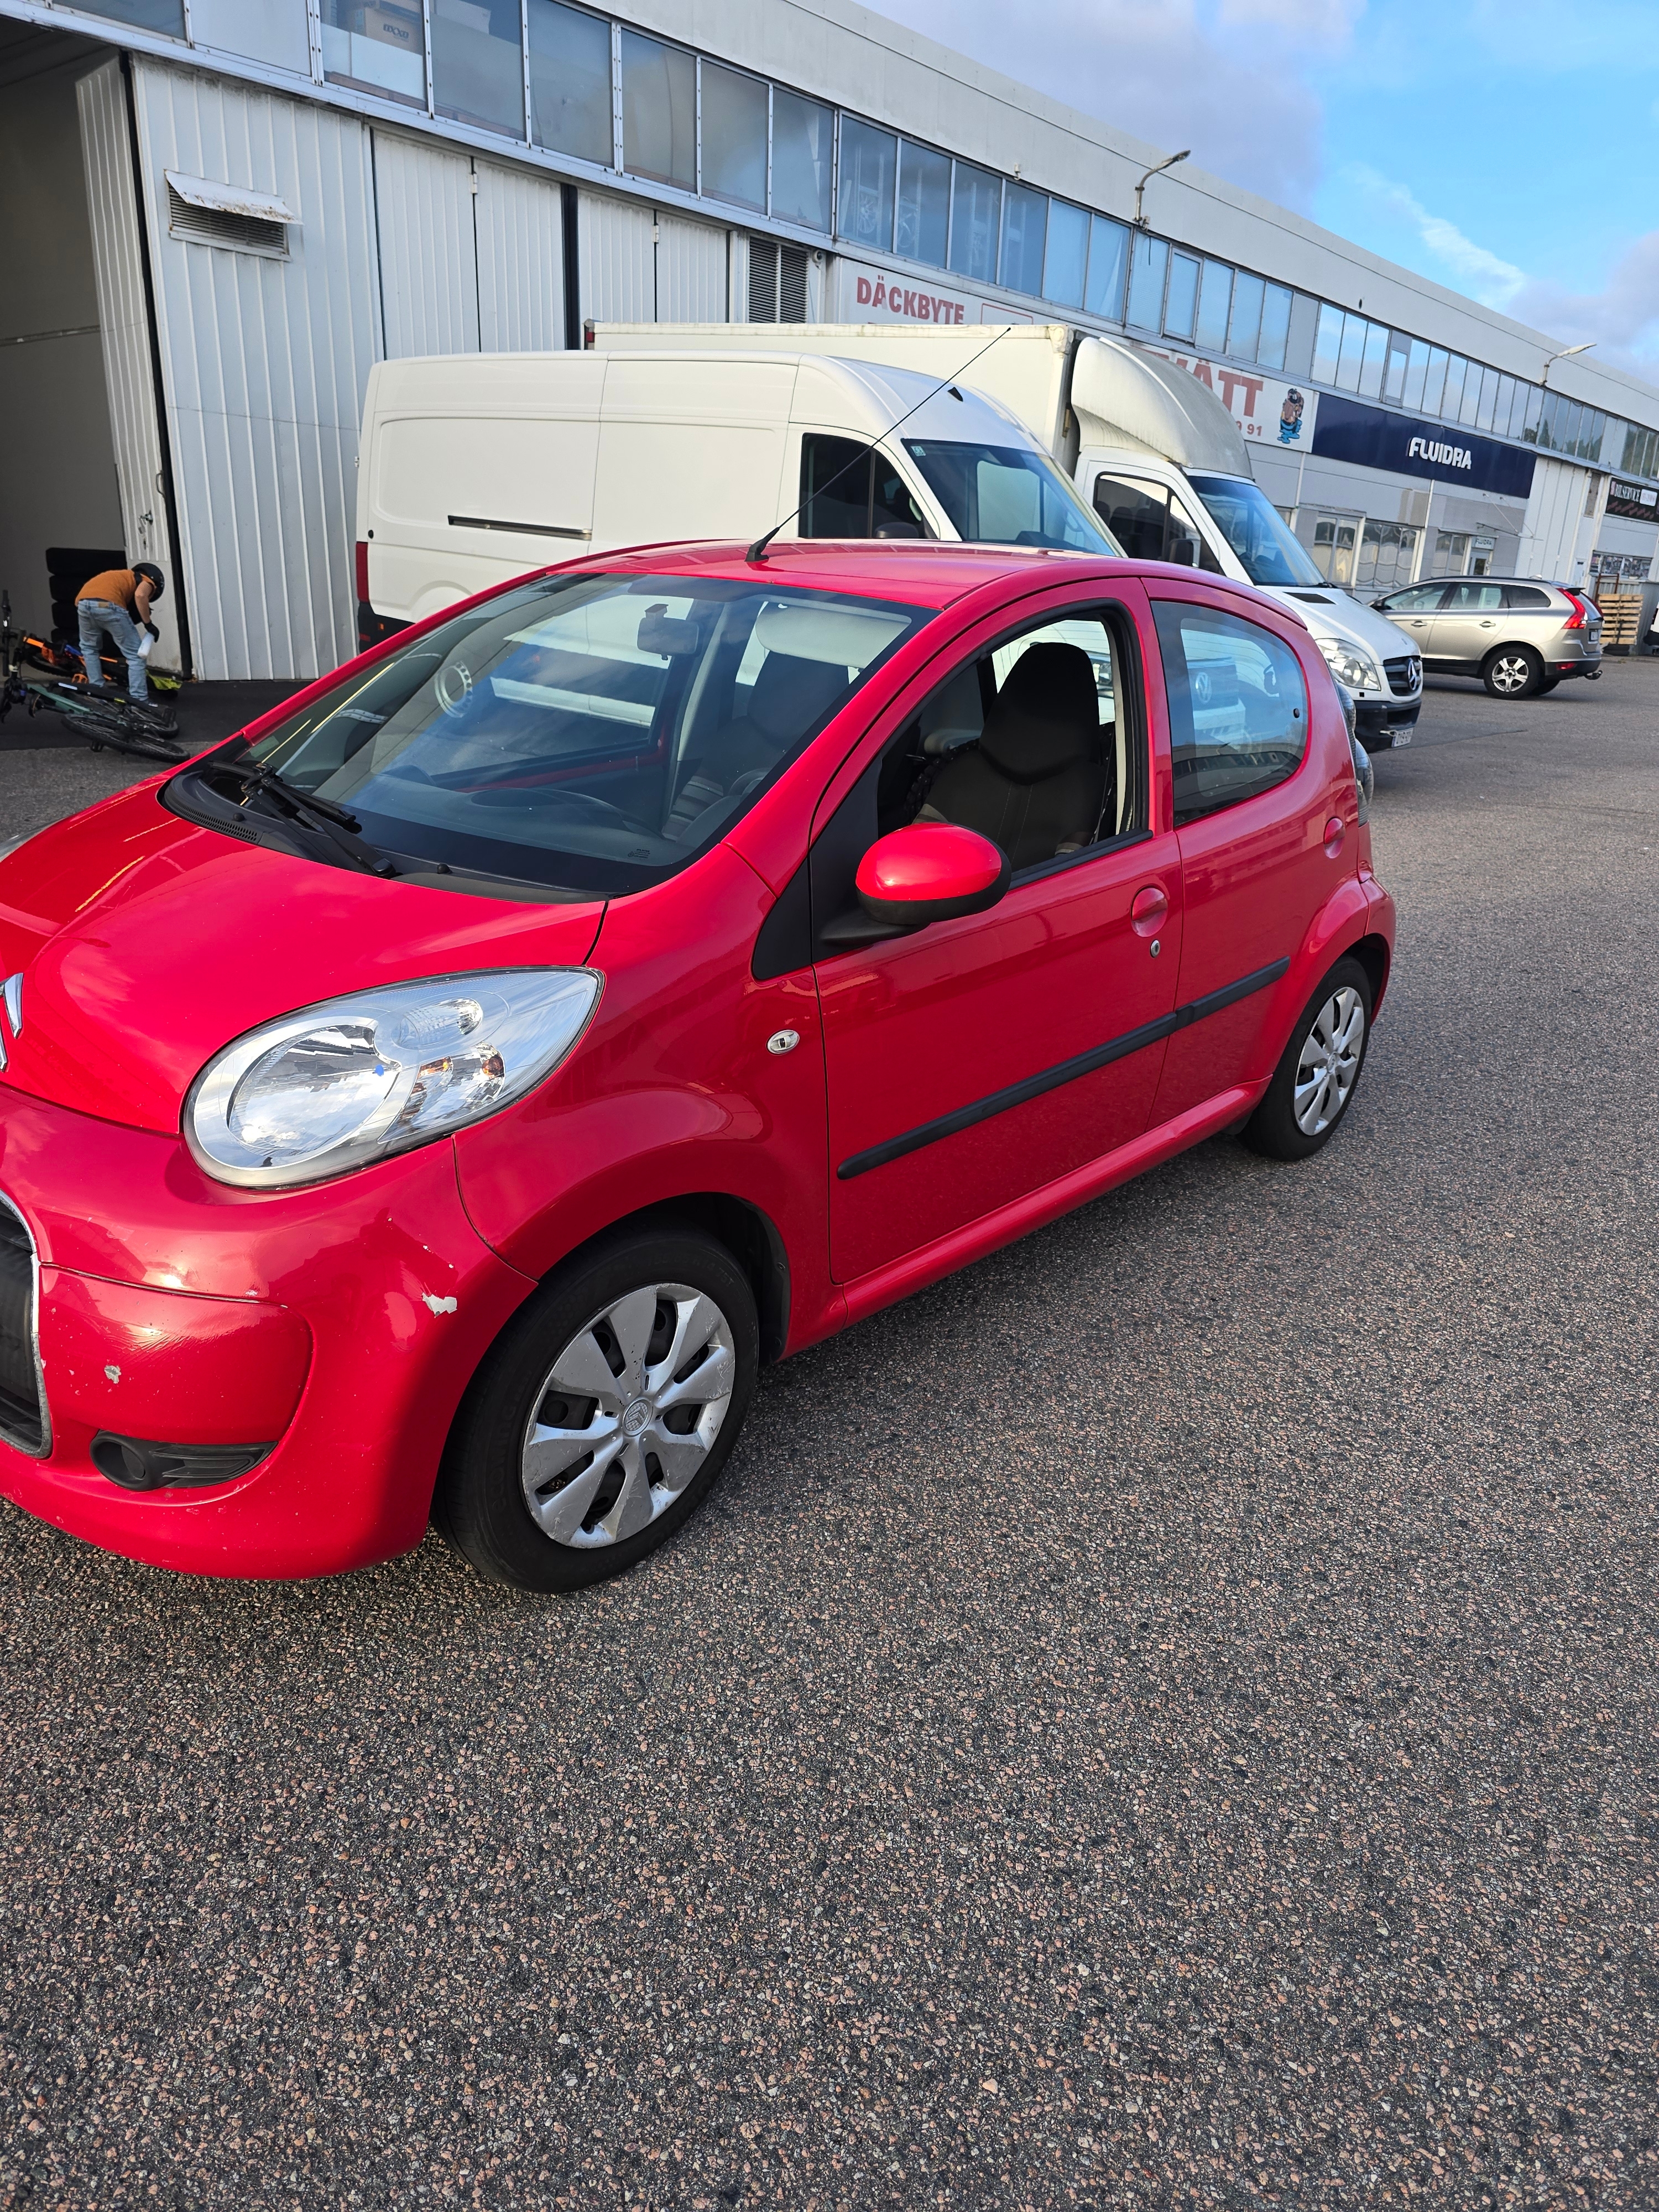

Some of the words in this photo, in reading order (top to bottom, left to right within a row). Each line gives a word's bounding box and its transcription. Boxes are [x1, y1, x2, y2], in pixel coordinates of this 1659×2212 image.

[857, 275, 964, 325] DÄCKBYTE
[1246, 424, 1262, 436] 91
[1408, 437, 1472, 470] FLUIDRA
